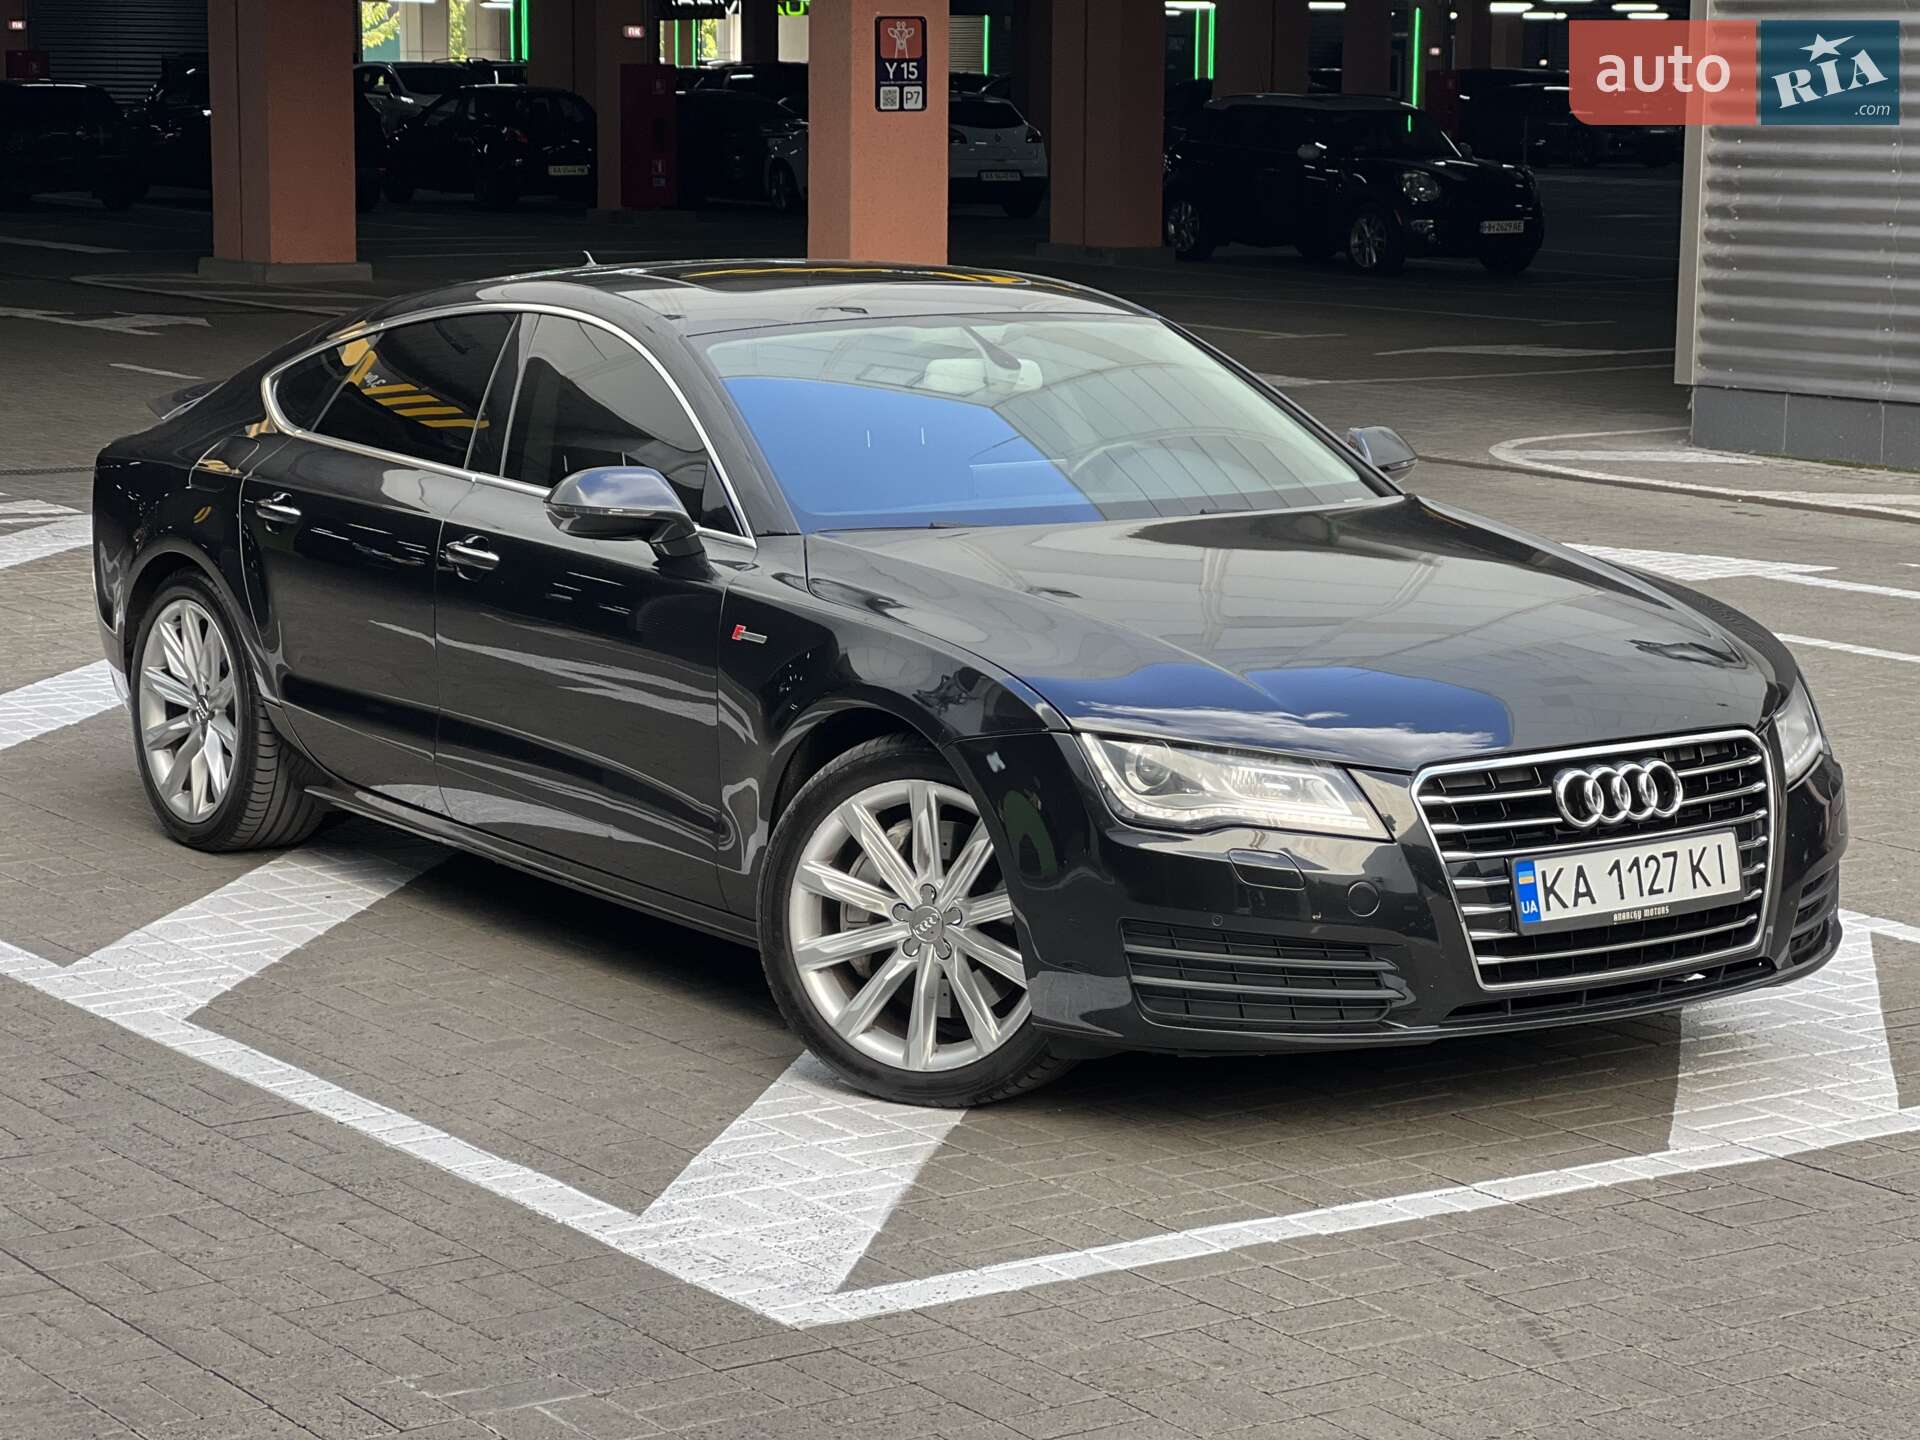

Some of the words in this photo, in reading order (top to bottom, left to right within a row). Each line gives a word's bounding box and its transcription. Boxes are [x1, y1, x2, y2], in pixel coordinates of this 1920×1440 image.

[885, 62, 898, 80] Y
[900, 62, 919, 80] 15
[905, 90, 921, 105] P7
[1541, 864, 1597, 912] KA
[1607, 850, 1678, 900] 1127
[1688, 844, 1726, 889] KI
[1521, 902, 1539, 914] UA
